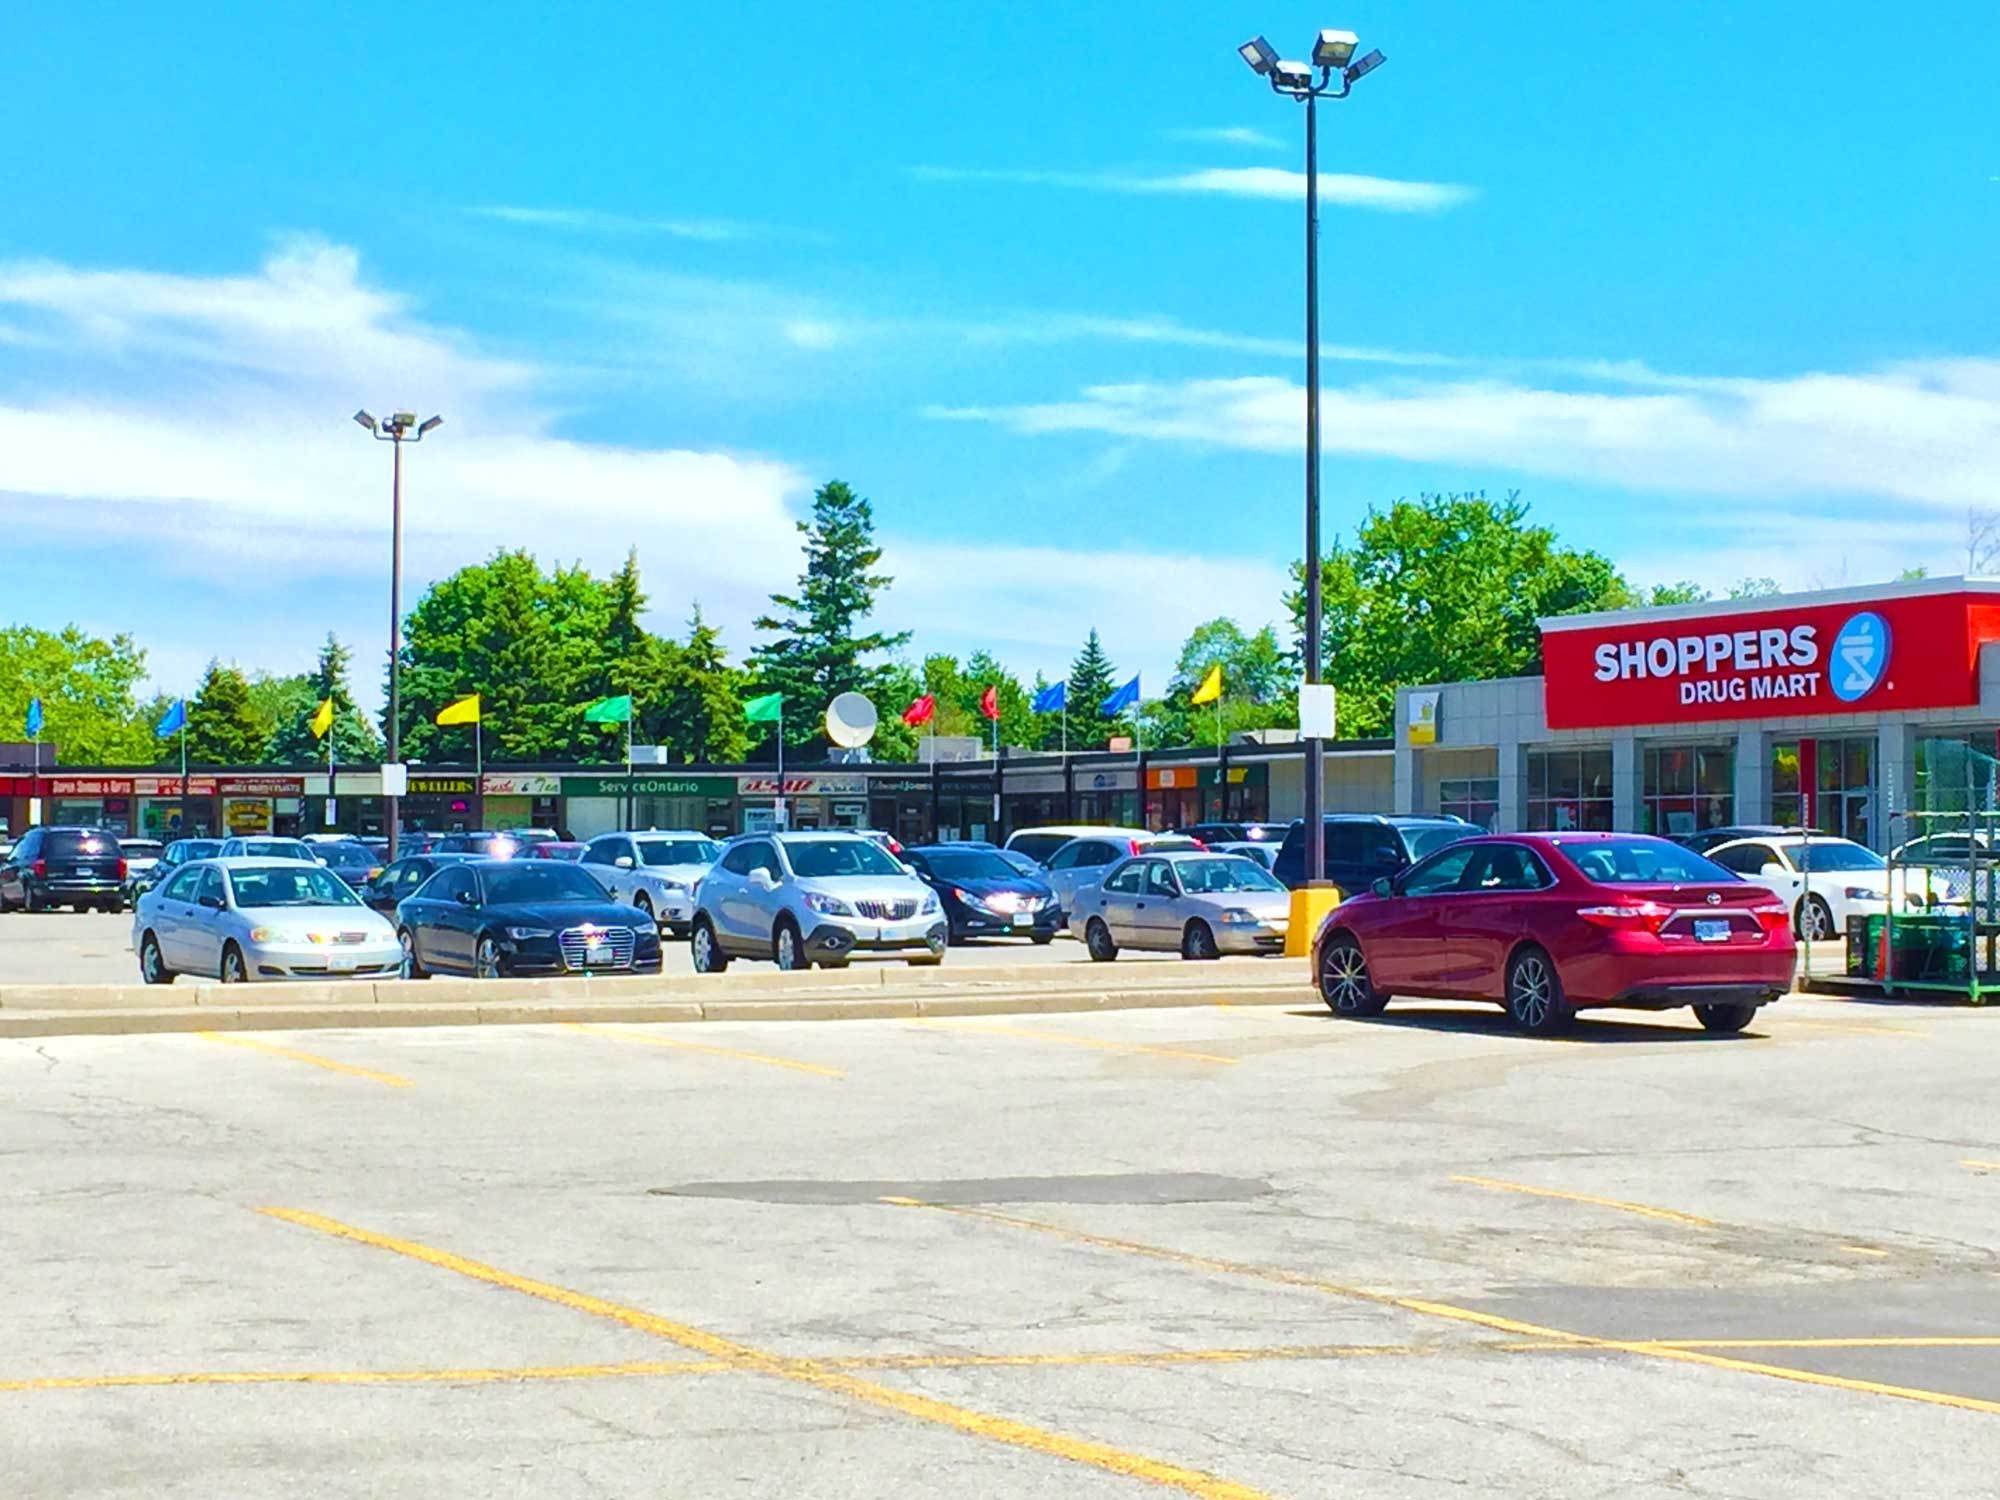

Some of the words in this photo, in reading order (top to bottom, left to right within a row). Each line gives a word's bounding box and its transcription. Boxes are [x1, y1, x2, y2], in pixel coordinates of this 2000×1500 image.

[1594, 625, 1818, 682] SHOPPERS
[1680, 677, 1746, 704] DRUG
[1751, 672, 1821, 700] MART
[599, 780, 699, 793] ServceOntario
